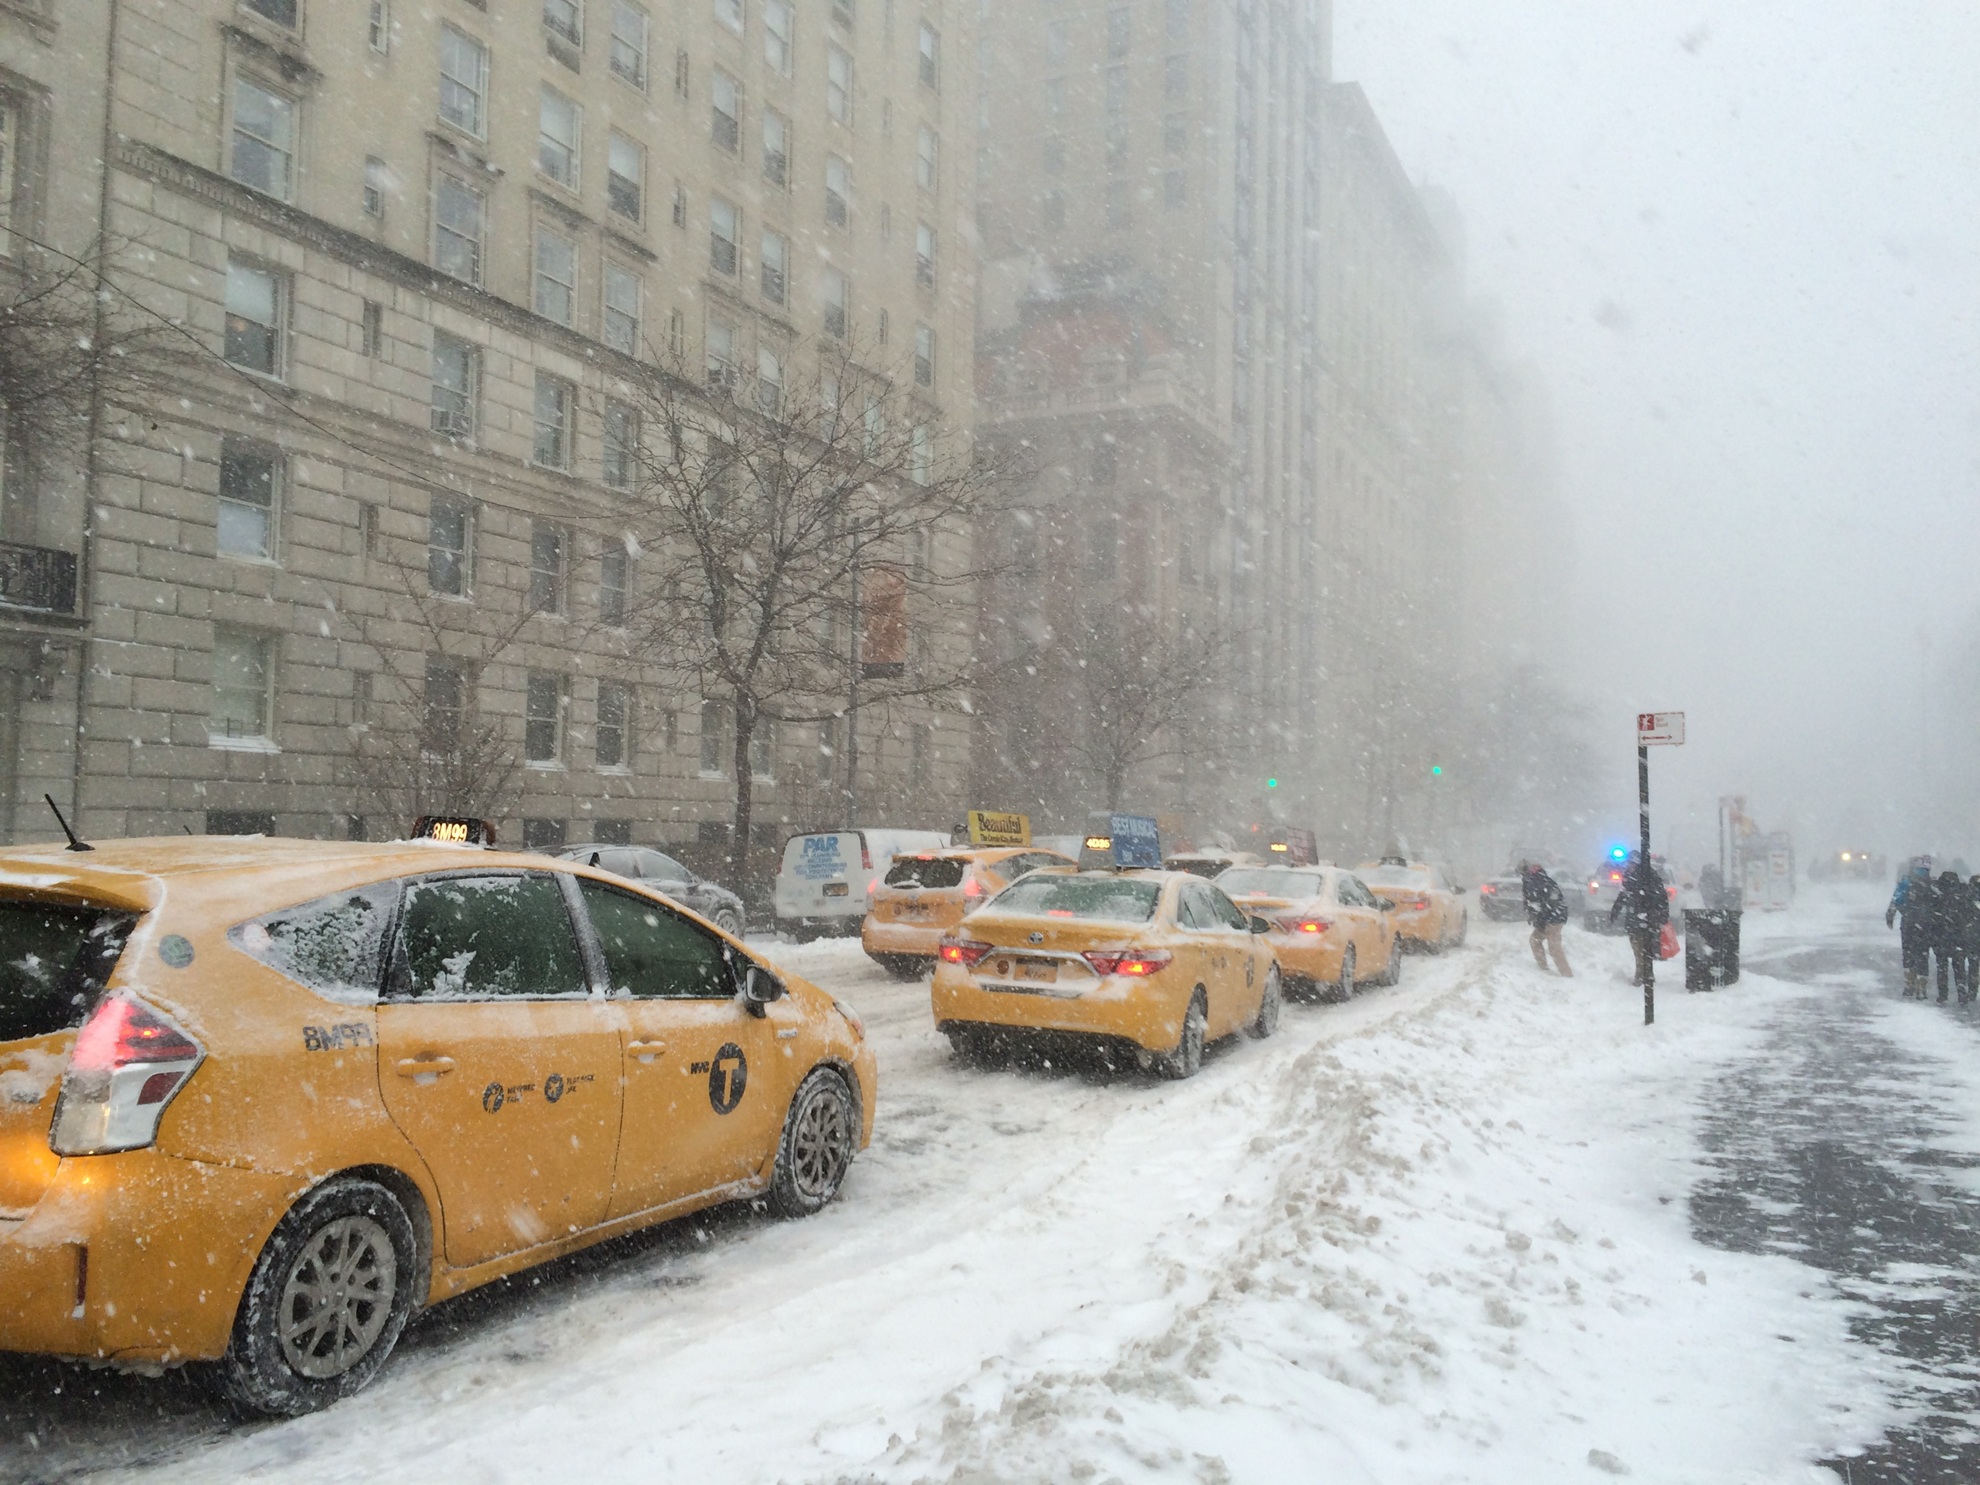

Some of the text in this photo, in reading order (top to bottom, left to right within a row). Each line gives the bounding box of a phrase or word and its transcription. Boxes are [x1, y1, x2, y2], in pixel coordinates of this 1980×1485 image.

[432, 822, 468, 842] 8M99
[803, 836, 839, 853] PAR
[303, 1023, 373, 1051] 8M99
[691, 1061, 709, 1074] NYC
